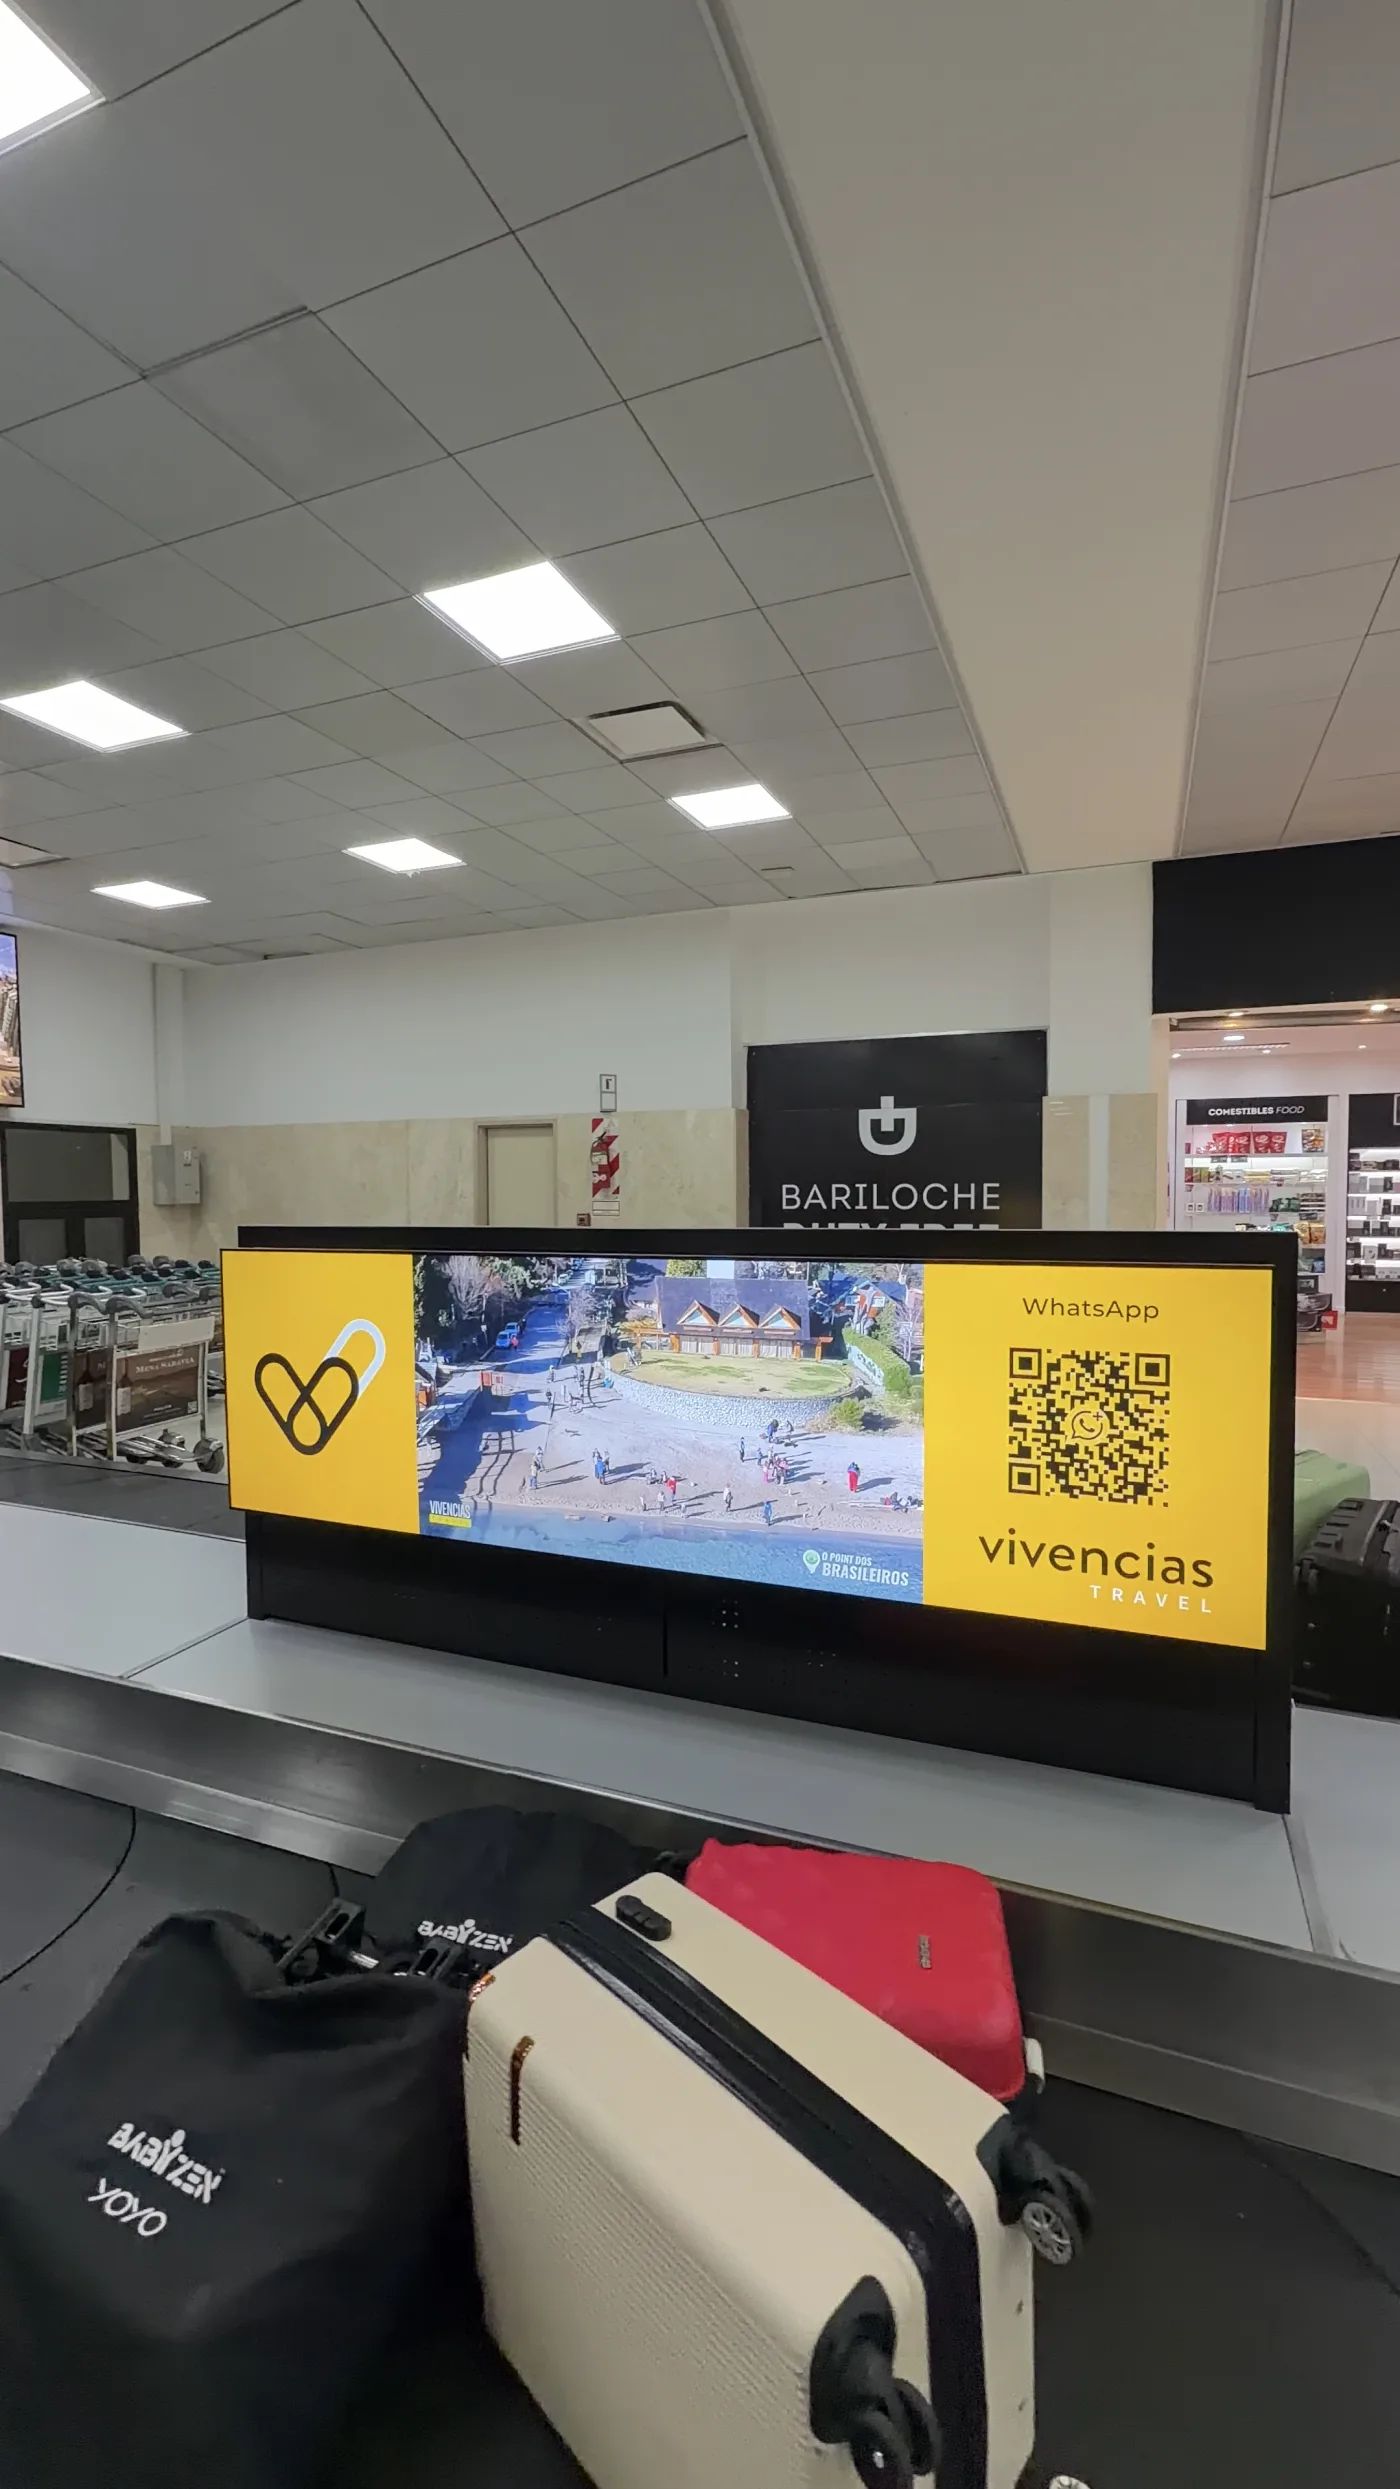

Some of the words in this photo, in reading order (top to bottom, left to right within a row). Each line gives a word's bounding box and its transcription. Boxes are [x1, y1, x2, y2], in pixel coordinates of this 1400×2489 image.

[1208, 1106, 1274, 1116] COMESTIBLES
[1275, 1105, 1305, 1115] FOOD
[781, 1182, 1000, 1211] BARILOCHE
[1022, 1297, 1160, 1323] WhatsApp
[429, 1499, 471, 1519] VIVENCIAS
[821, 1551, 828, 1561] O
[829, 1553, 854, 1565] POINT
[855, 1555, 873, 1567] DOS
[978, 1527, 1215, 1588] vivencias
[821, 1562, 910, 1587] BRASILEIROS
[1089, 1584, 1212, 1614] TRAVEL
[417, 1918, 513, 1953] BABYZEN
[107, 2122, 222, 2204] BABYZEN
[88, 2177, 167, 2237] YOYO
